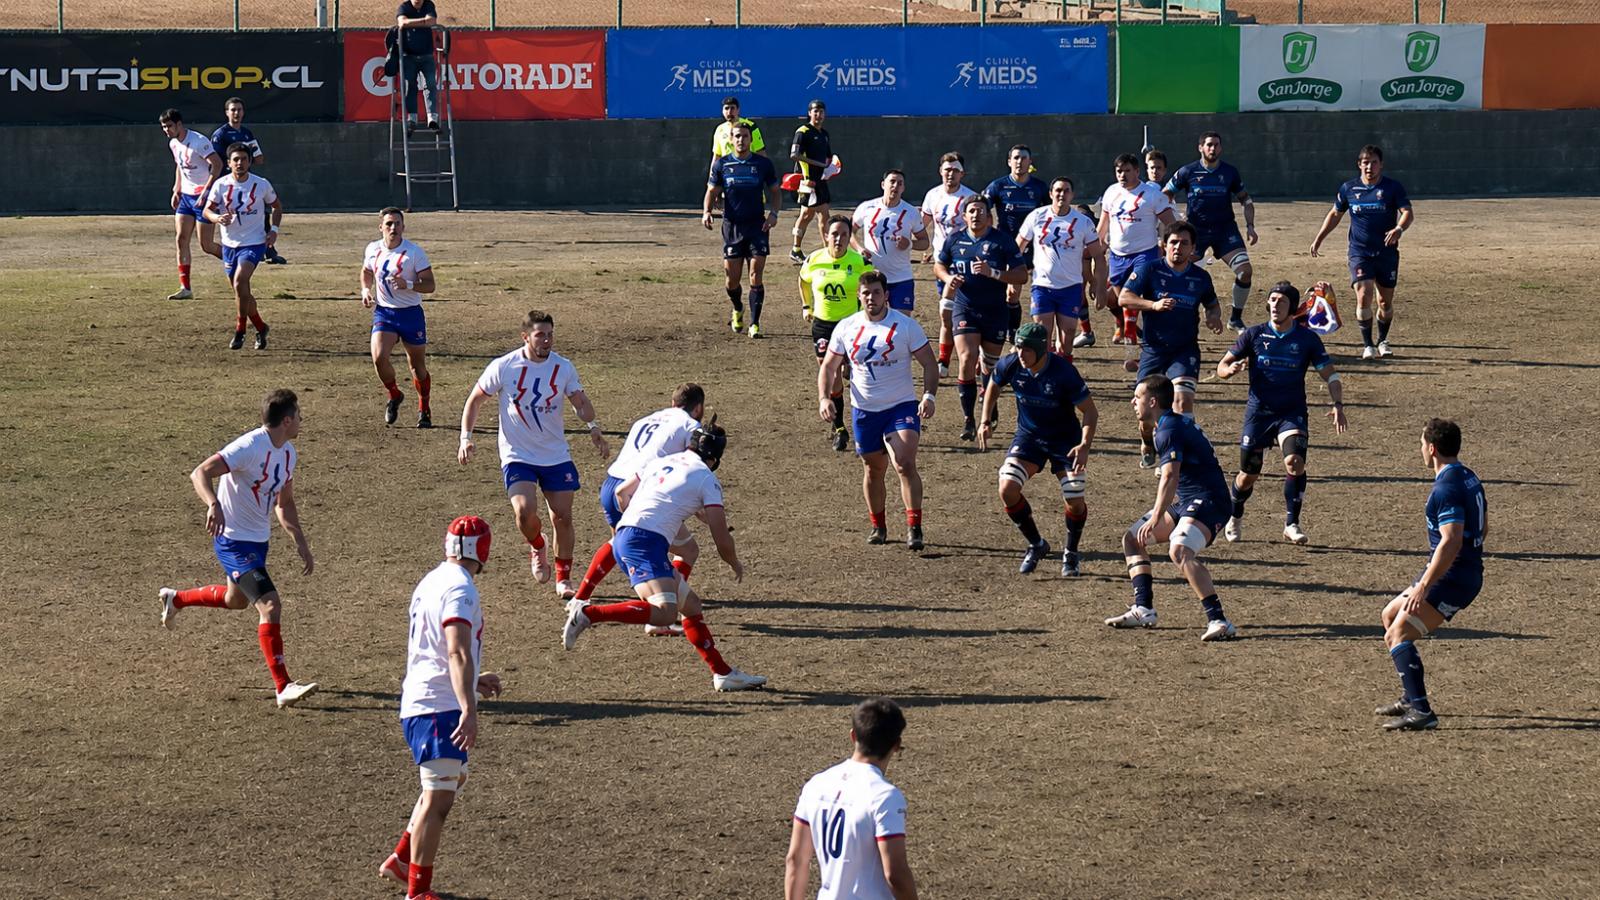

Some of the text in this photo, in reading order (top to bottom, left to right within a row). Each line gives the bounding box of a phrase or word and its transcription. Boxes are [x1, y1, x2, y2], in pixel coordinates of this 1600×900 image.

[699, 60, 743, 69] CLINICA
[843, 58, 886, 67] CLINICA
[985, 57, 1028, 65] CLINICA
[693, 69, 752, 88] MEDS
[836, 67, 896, 86] MEDS
[978, 66, 1038, 85] MEDS
[634, 423, 660, 452] 15
[822, 807, 846, 864] 10
